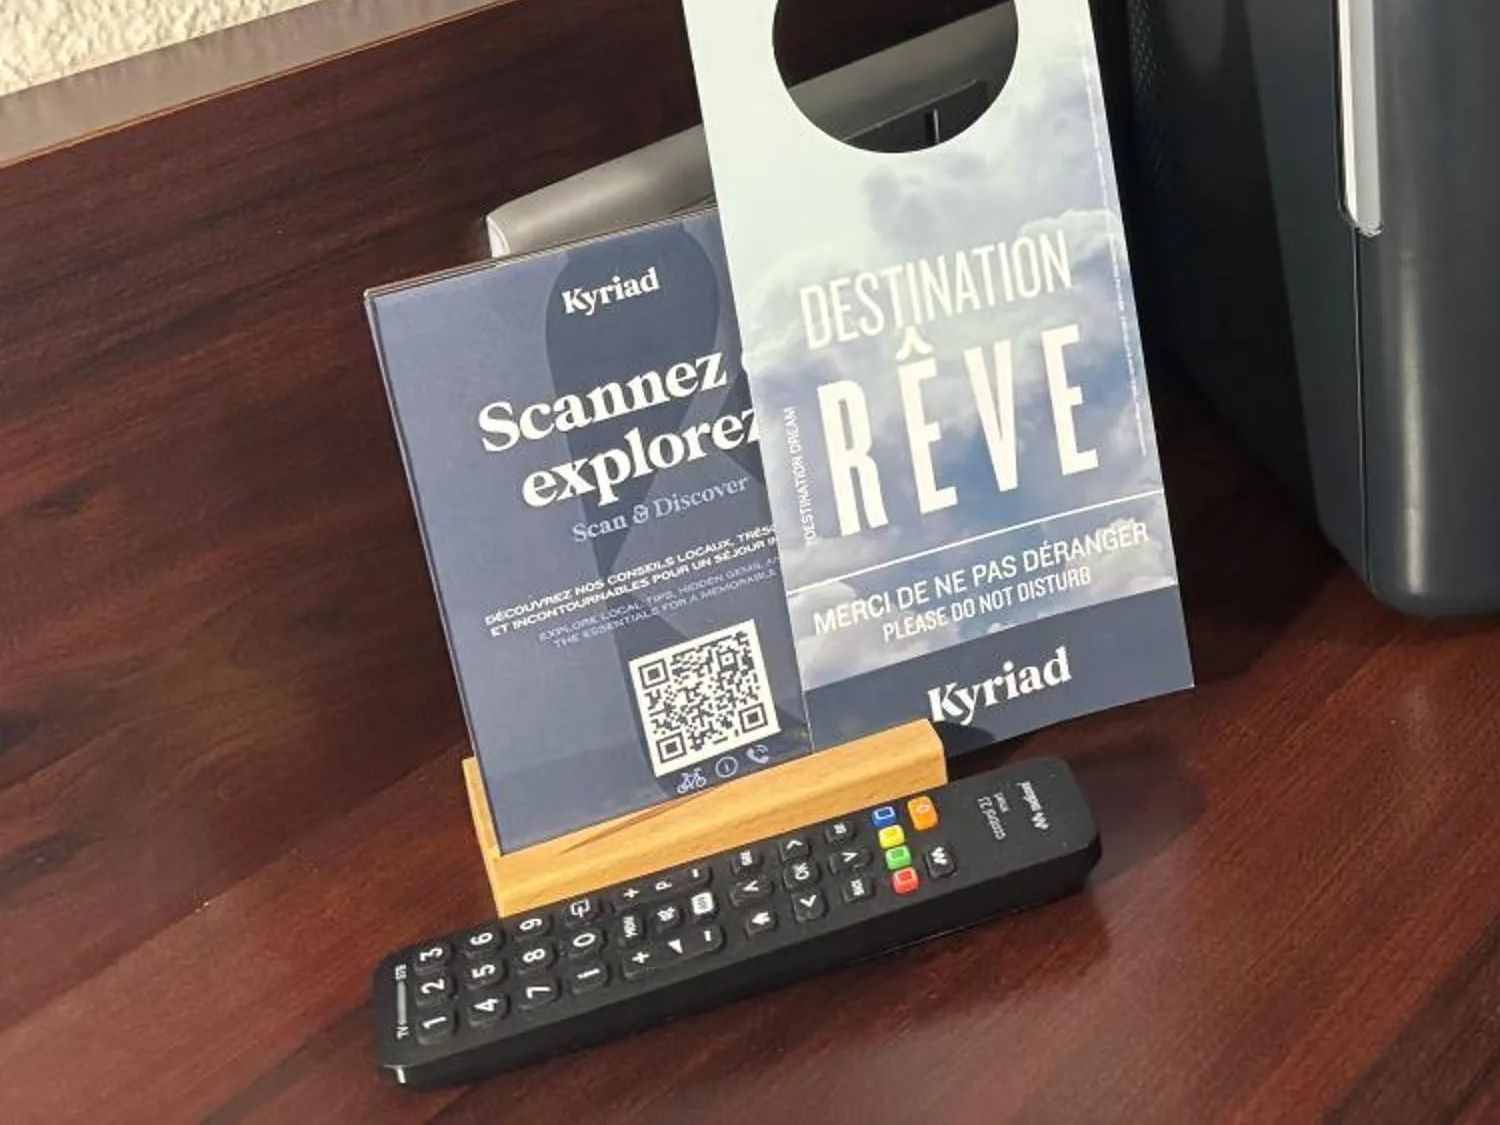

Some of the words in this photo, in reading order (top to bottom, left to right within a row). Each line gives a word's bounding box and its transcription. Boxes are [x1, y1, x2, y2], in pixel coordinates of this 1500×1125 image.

[561, 267, 661, 316] Kyriad
[799, 230, 1074, 350] DESTINATION
[478, 351, 728, 453] Scannez
[817, 324, 1100, 537] RÊVE
[572, 516, 628, 542] Scan
[632, 503, 650, 525] &
[654, 475, 750, 519] Discover
[813, 592, 892, 636] MERCI
[897, 579, 931, 611] DE
[934, 568, 969, 599] NE
[972, 553, 1019, 590] PAS
[1023, 520, 1150, 574] DÉRANGER
[490, 623, 511, 638] ET
[652, 564, 691, 585] POUR
[692, 557, 712, 573] UN
[573, 579, 605, 600] NOS
[882, 606, 949, 644] PLEASE
[951, 599, 977, 624] DO
[979, 586, 1014, 616] NOT
[1017, 565, 1093, 603] DISTURB
[927, 646, 1073, 727] Kyriad
[519, 917, 543, 932] 9
[470, 931, 494, 947] 6
[419, 946, 444, 963] 3
[522, 947, 547, 963] 8
[472, 962, 497, 979] 5
[420, 977, 446, 995] 2
[525, 984, 551, 1001] 7
[473, 996, 499, 1013] 4
[422, 1014, 448, 1031] 1
